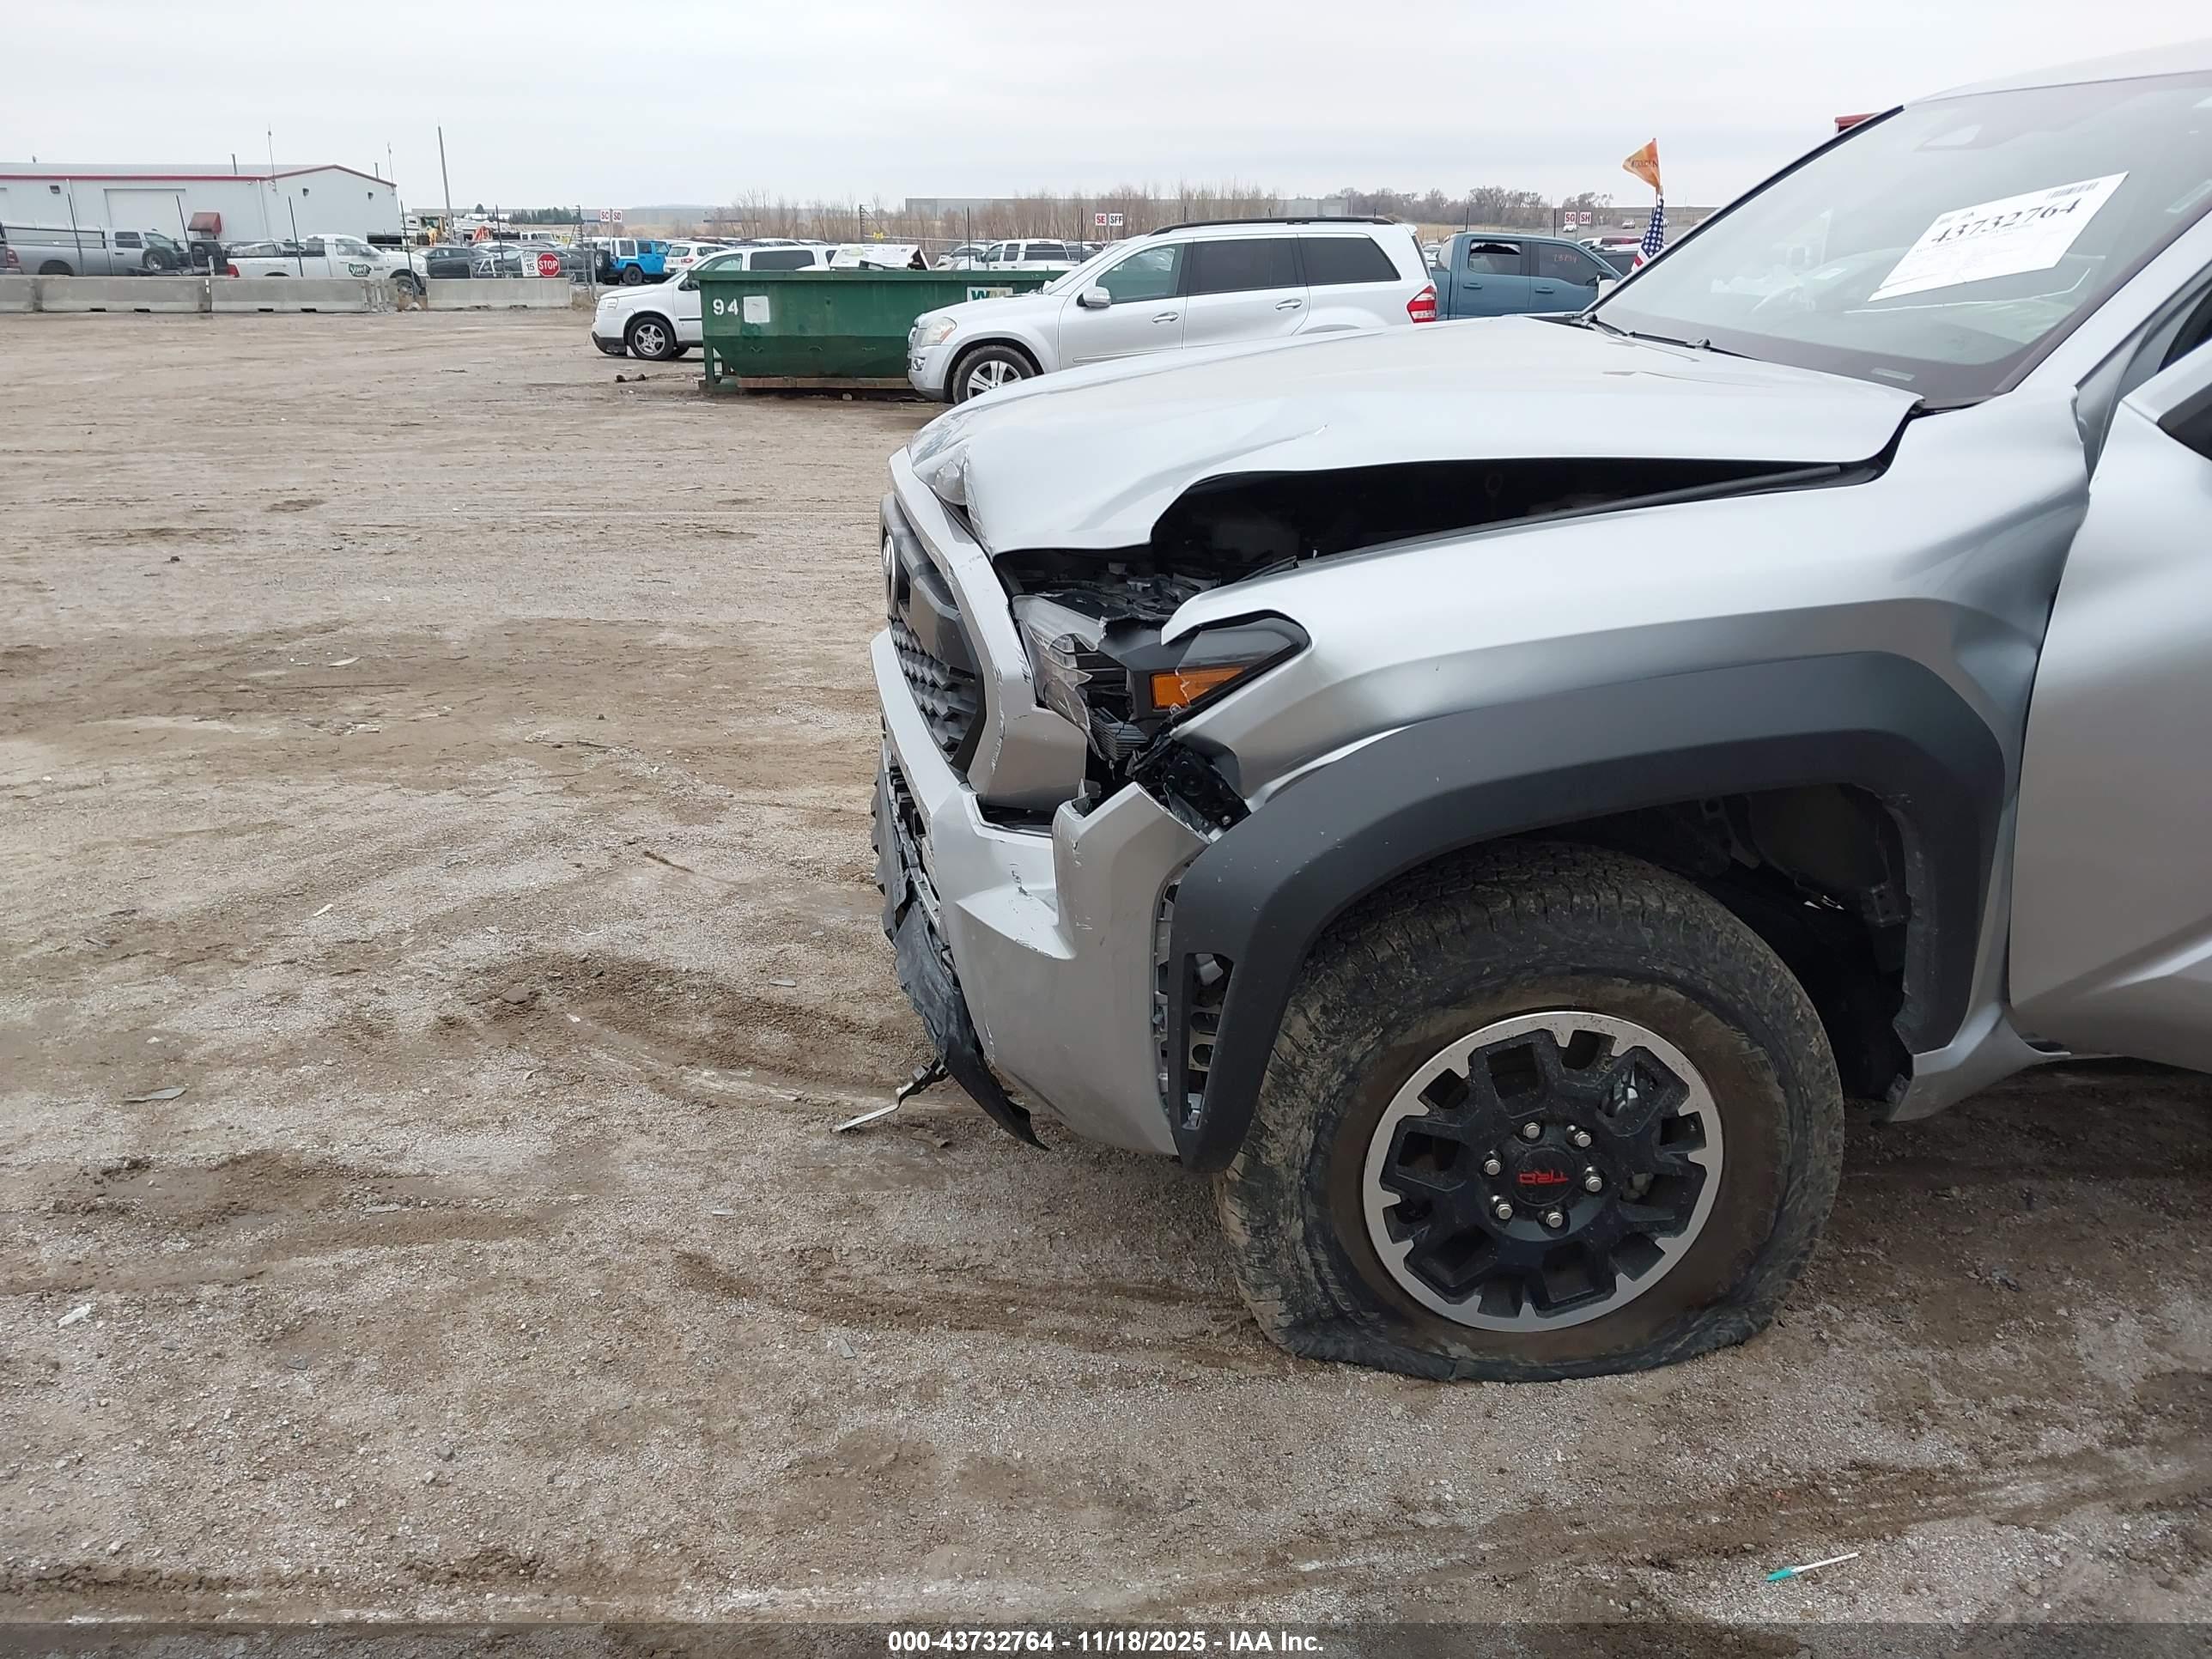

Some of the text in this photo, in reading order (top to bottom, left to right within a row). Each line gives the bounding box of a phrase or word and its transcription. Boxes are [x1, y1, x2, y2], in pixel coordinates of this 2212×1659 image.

[1097, 215, 1105, 224] SE
[1110, 215, 1123, 224] SFF
[1581, 214, 1590, 222] SH
[1931, 198, 2082, 243] 43732764
[526, 263, 536, 271] 15
[538, 260, 558, 270] STOP
[713, 298, 738, 315] 94
[1519, 1170, 1570, 1185] TRD
